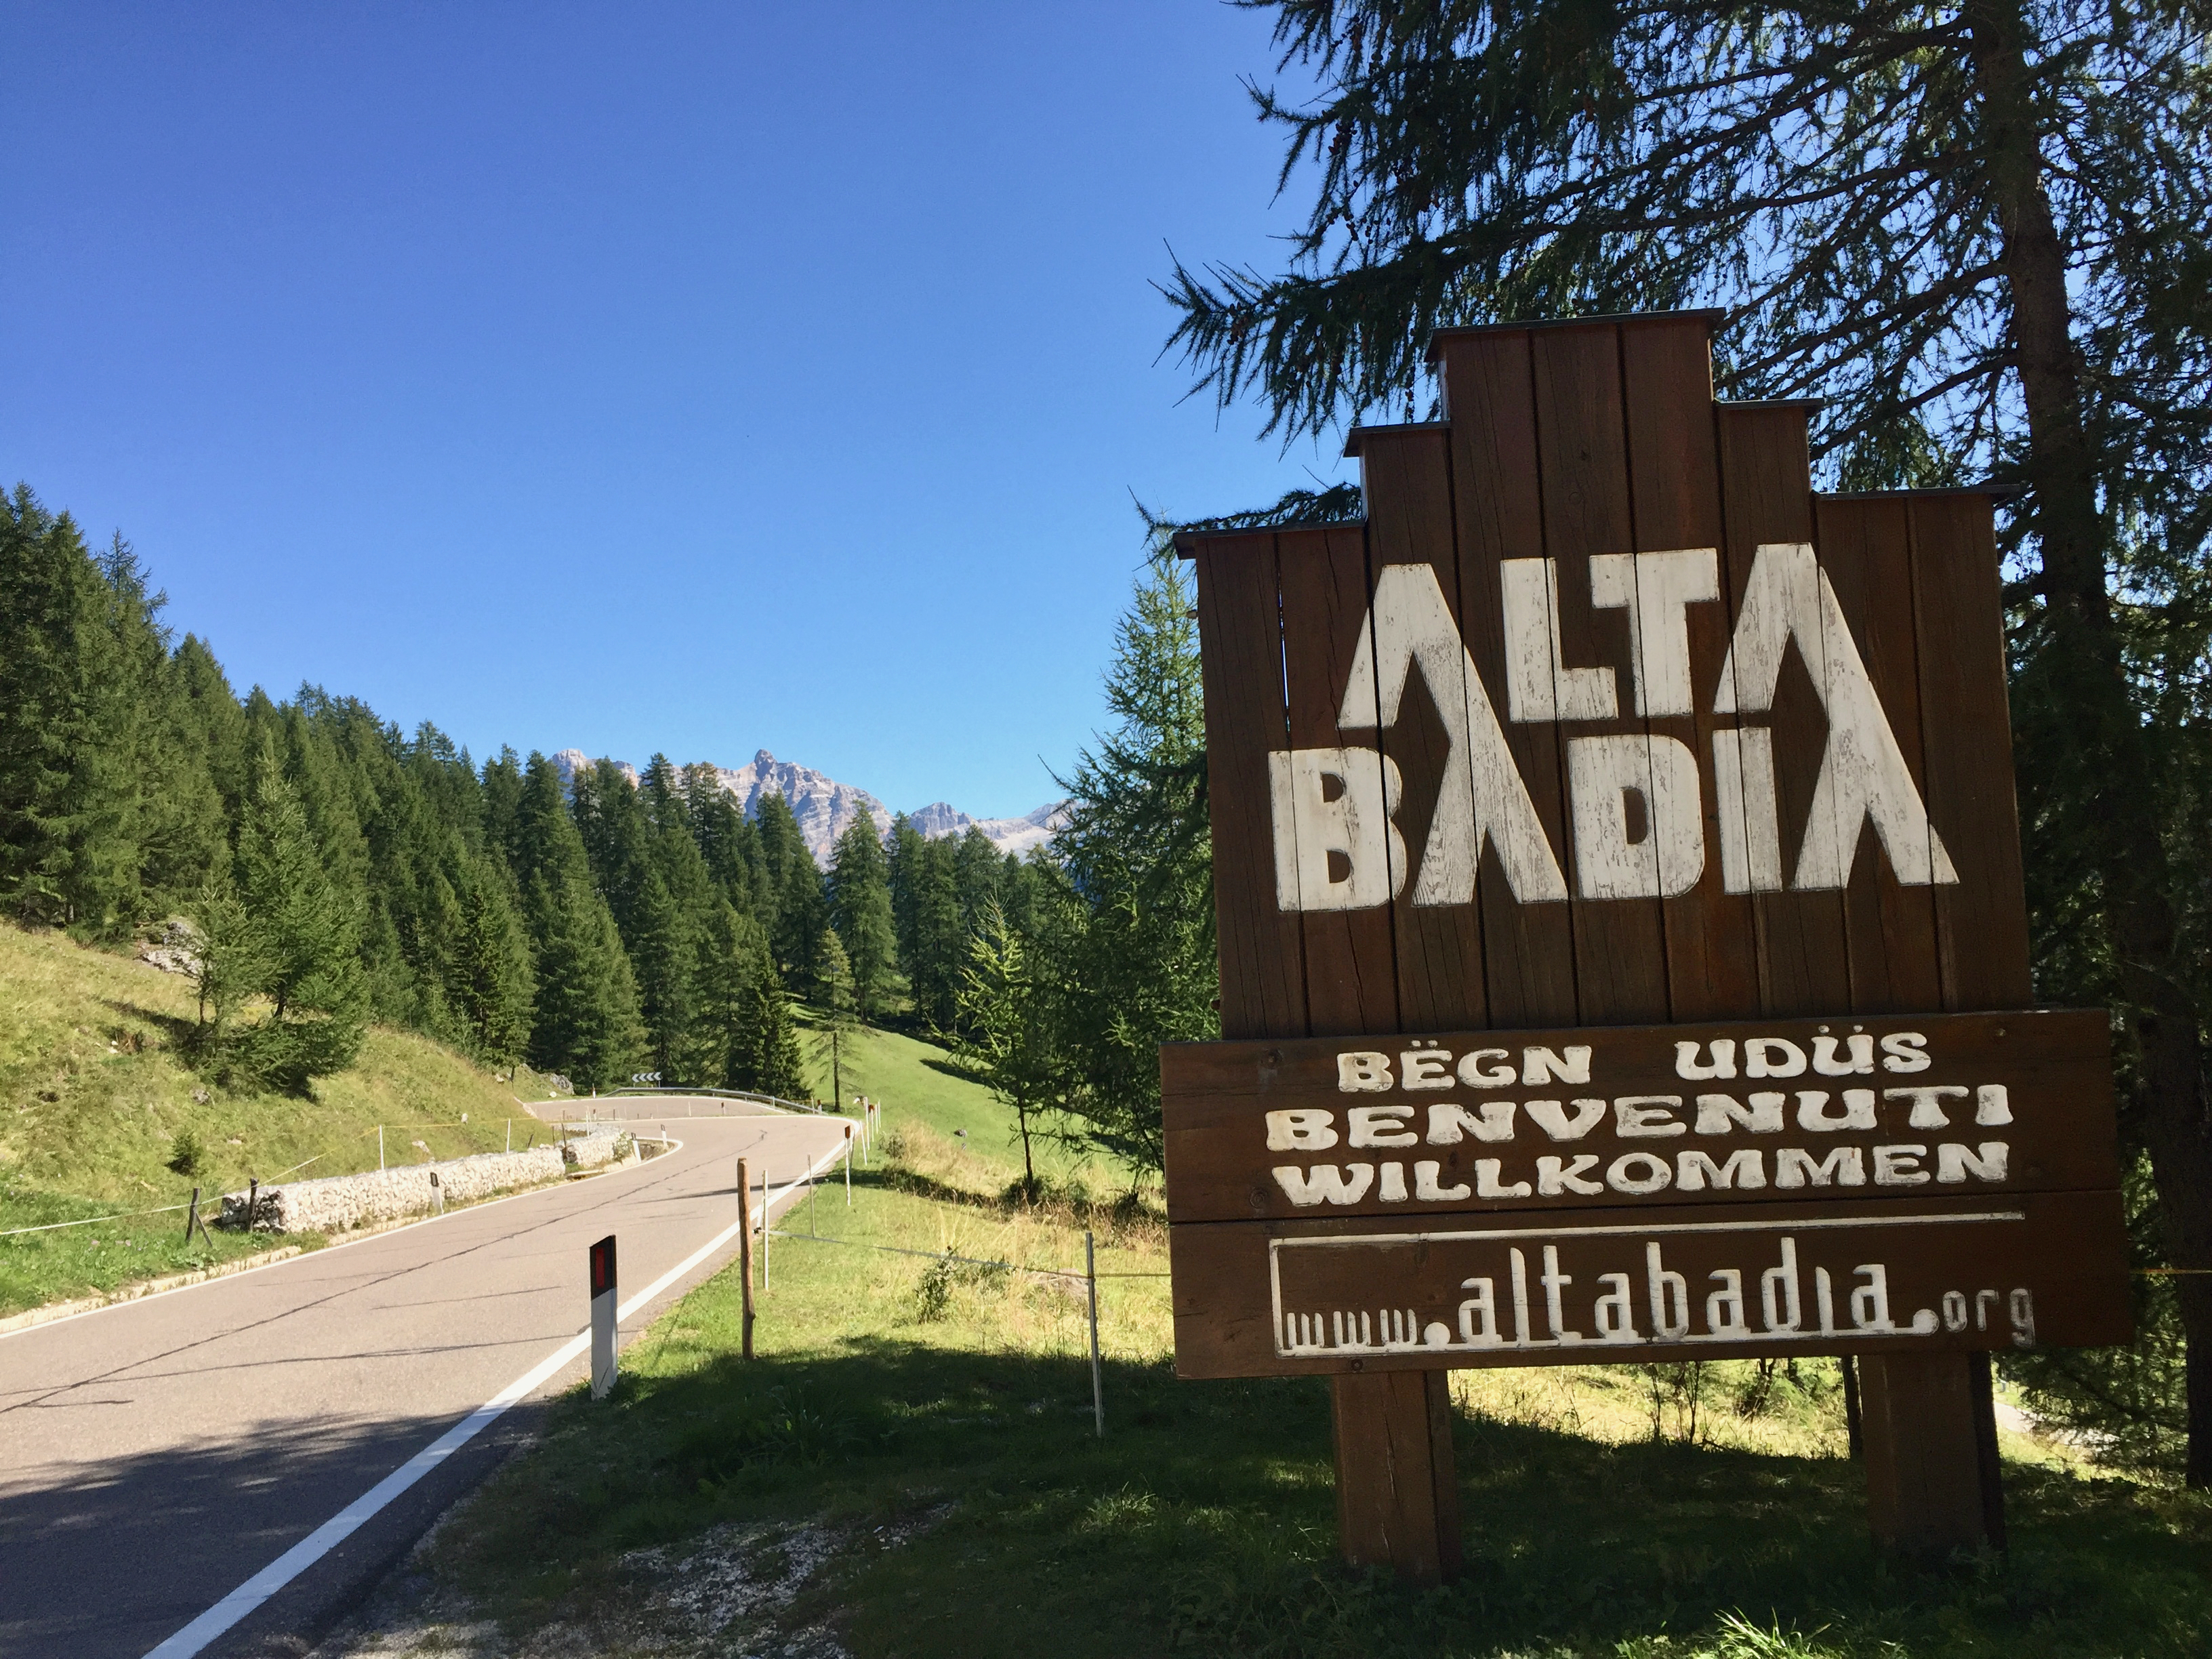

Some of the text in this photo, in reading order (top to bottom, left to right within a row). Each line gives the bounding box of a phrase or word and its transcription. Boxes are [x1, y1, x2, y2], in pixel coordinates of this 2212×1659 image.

[1337, 542, 1879, 730] ALTA
[1268, 726, 1960, 912] BADIA
[1336, 1024, 1932, 1093] BËGN UDÜS
[1265, 1083, 2013, 1152] BENVENUTI
[1271, 1141, 2009, 1207] WILLKOMMEN
